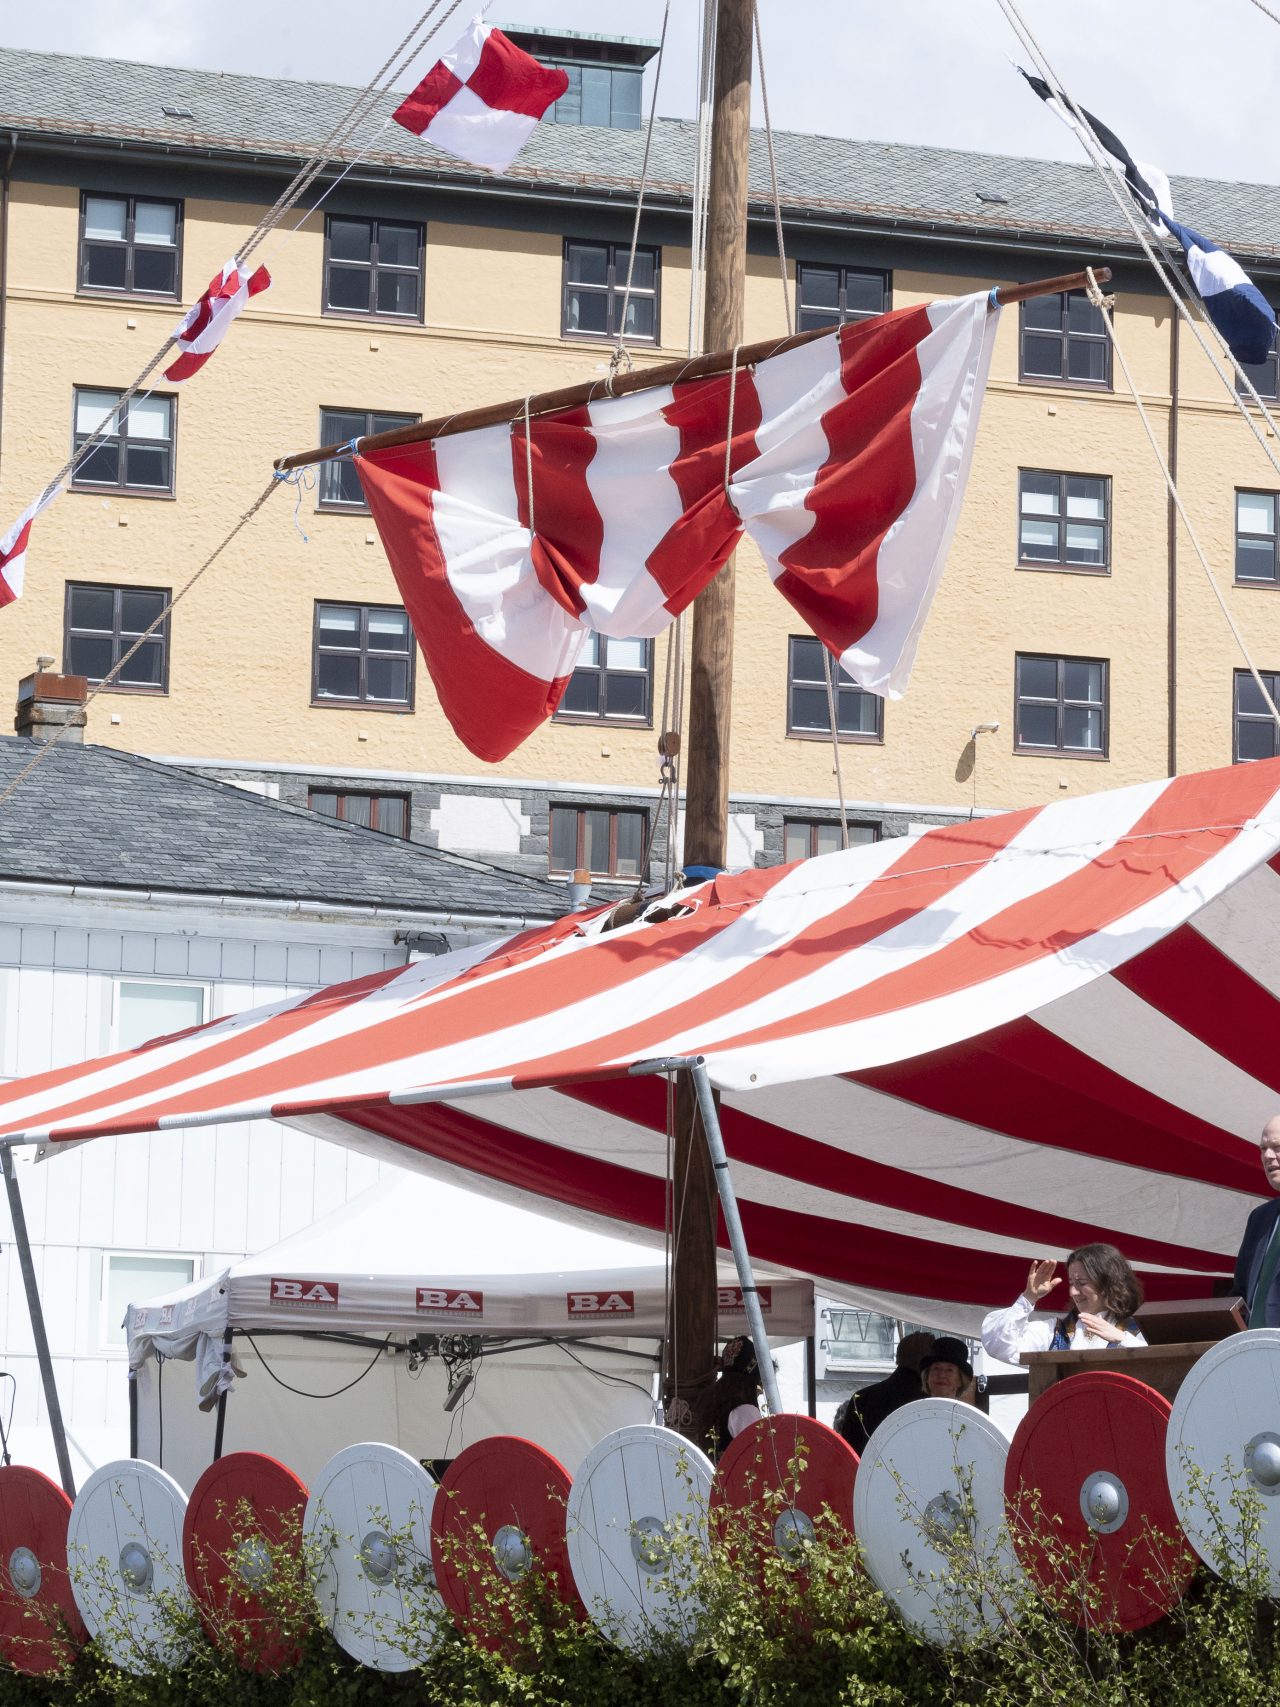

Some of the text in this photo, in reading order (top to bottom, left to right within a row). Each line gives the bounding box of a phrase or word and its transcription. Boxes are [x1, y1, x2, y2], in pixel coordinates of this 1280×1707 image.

[274, 1281, 335, 1302] BA
[419, 1290, 480, 1310] BA
[570, 1294, 632, 1312] BA
